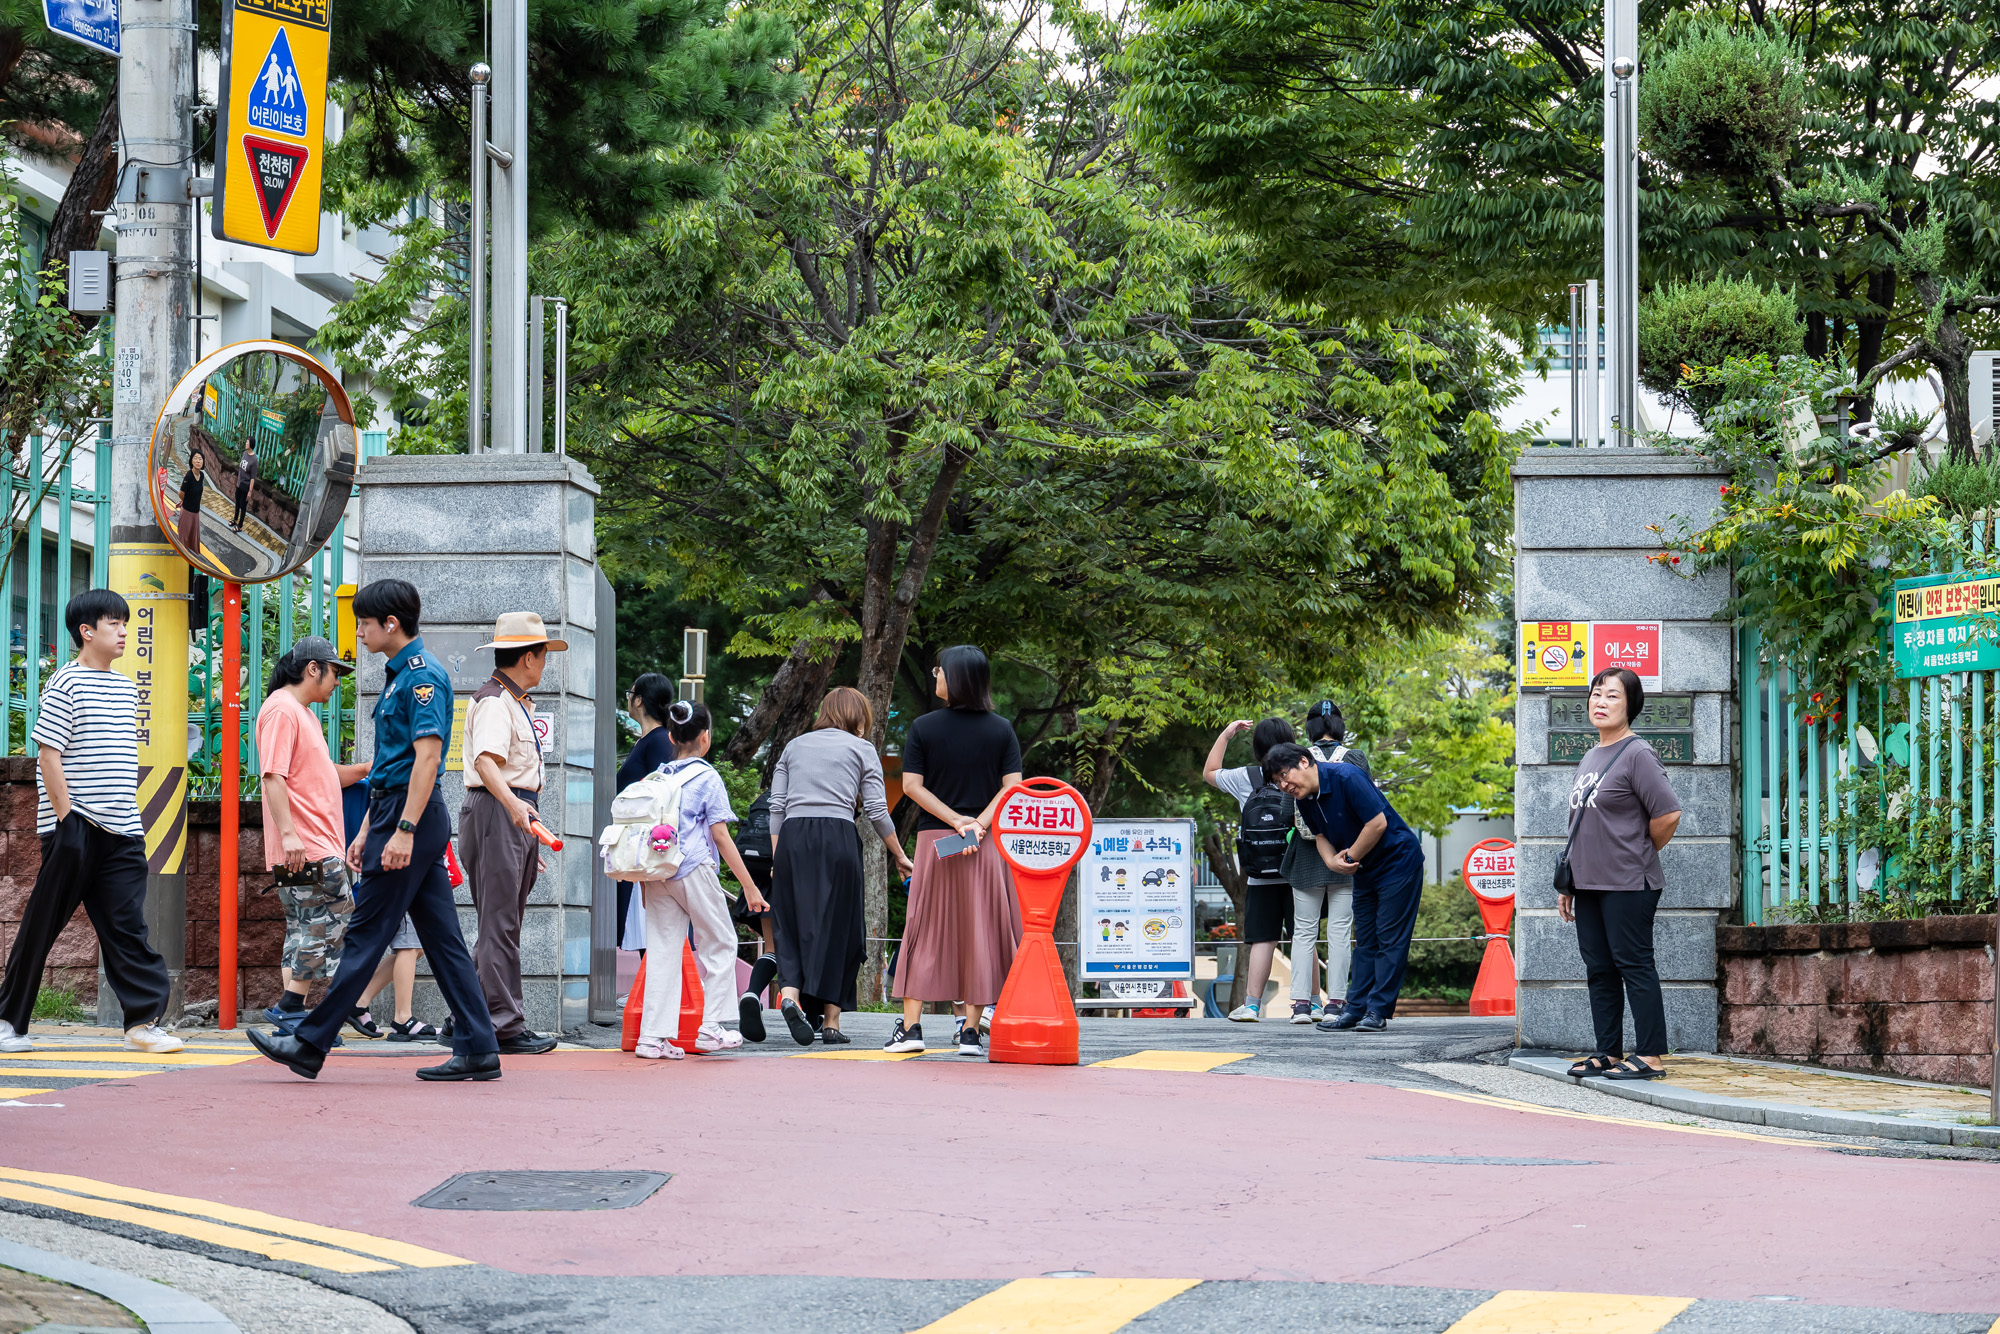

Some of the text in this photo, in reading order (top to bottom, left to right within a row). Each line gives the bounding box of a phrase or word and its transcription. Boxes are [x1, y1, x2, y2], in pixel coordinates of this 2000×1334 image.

[70, 14, 118, 50] Yeonseo-ro 37-gil
[252, 105, 303, 132] 어린이보호
[259, 153, 292, 179] 천천히
[263, 175, 284, 190] SLOW
[1897, 591, 1923, 618] 어린이
[1925, 589, 1943, 615] 안전
[136, 607, 154, 665] 어린이
[1947, 625, 1966, 643] 하지
[1604, 641, 1649, 659] 에스원
[1923, 650, 1979, 667] 서울연신초등학교
[135, 670, 152, 747] 보호구역
[1007, 805, 1076, 829] 주차금지
[1010, 839, 1071, 857] 서울연신초등학교
[1103, 836, 1171, 852] 예방 수칙
